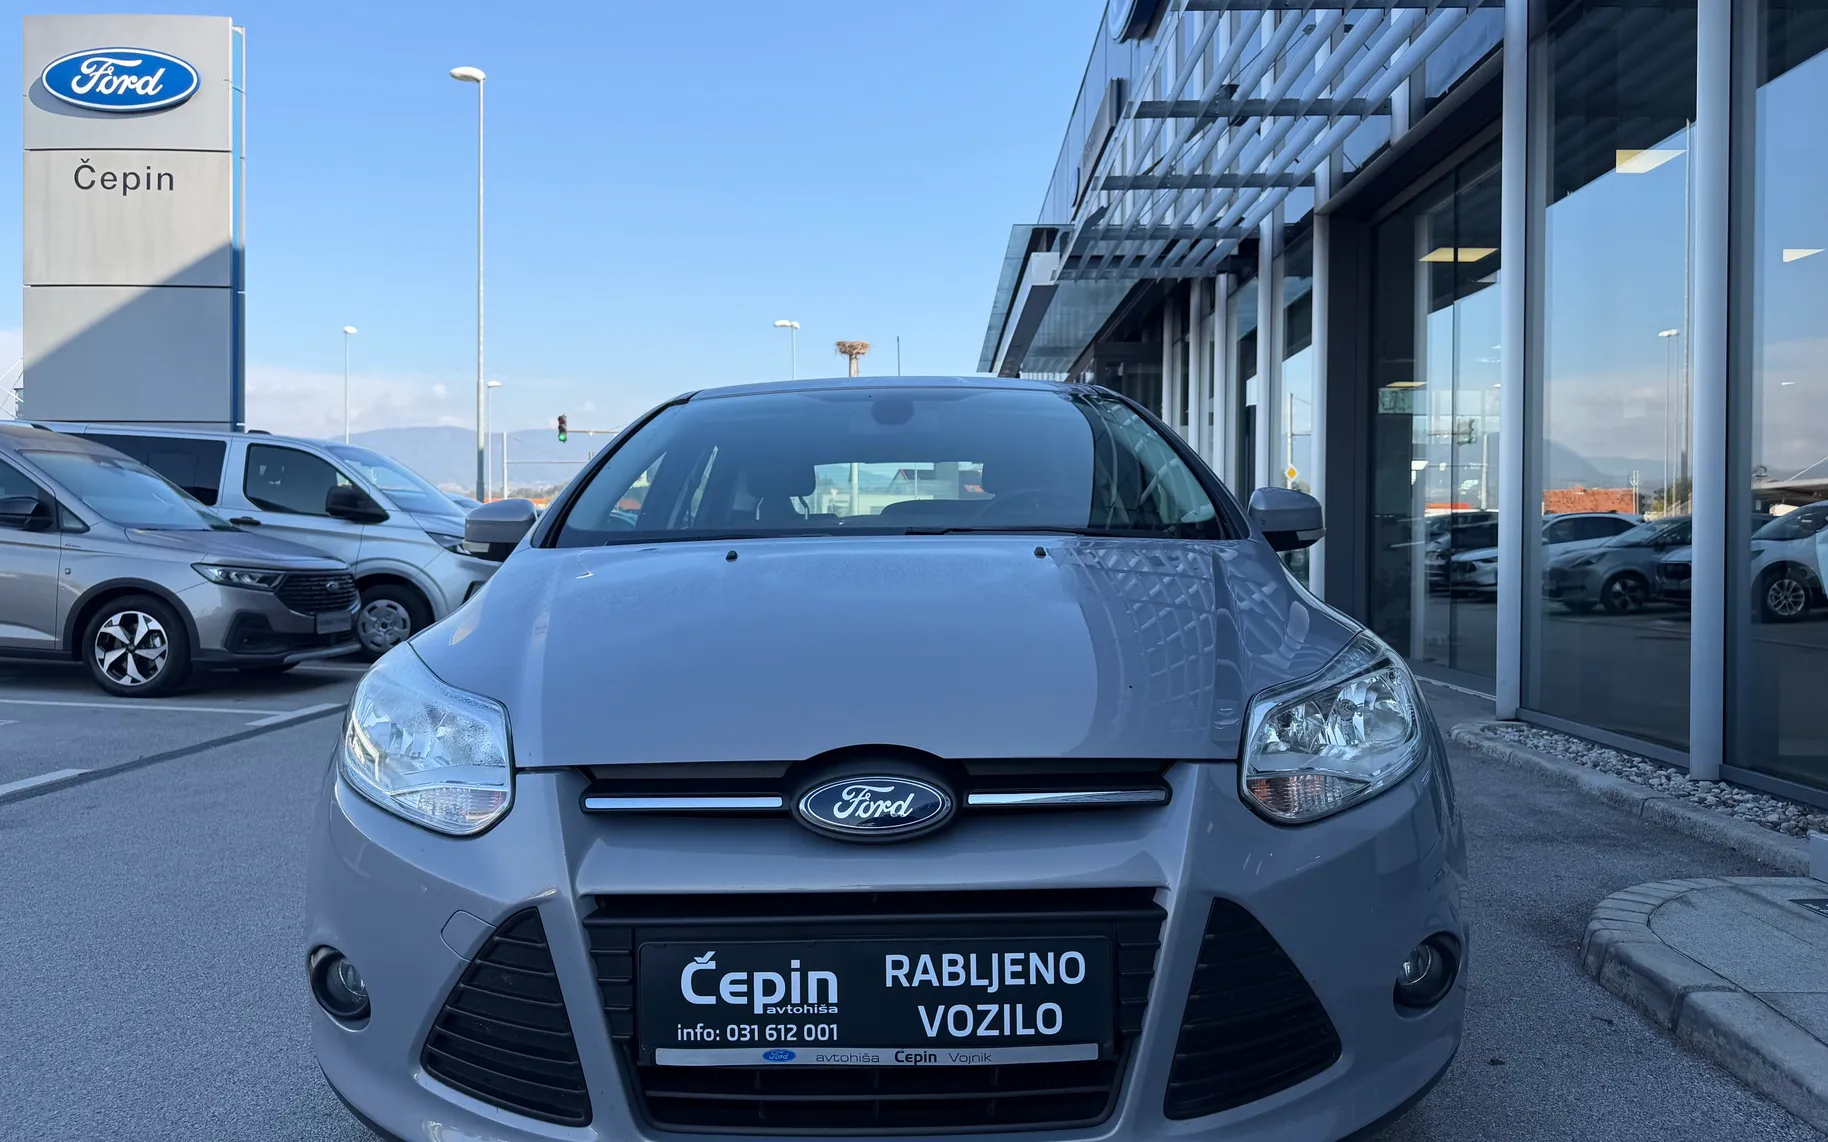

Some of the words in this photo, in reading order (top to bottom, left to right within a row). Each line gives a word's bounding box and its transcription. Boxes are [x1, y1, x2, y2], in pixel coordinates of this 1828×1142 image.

[71, 56, 166, 96] Ford
[73, 158, 174, 196] Čepin
[833, 784, 915, 819] Ford
[680, 950, 839, 1015] Čepin
[885, 951, 1086, 993] RABLJENO
[766, 1003, 839, 1015] avtohiša
[917, 1002, 1063, 1037] VOZILO
[677, 1023, 720, 1041] info:
[726, 1024, 759, 1041] 031
[765, 1024, 797, 1041] 612
[803, 1023, 838, 1041] 001
[815, 1052, 880, 1063] avtohiša
[894, 1047, 937, 1065] Čepin
[948, 1052, 992, 1064] Vojnik
